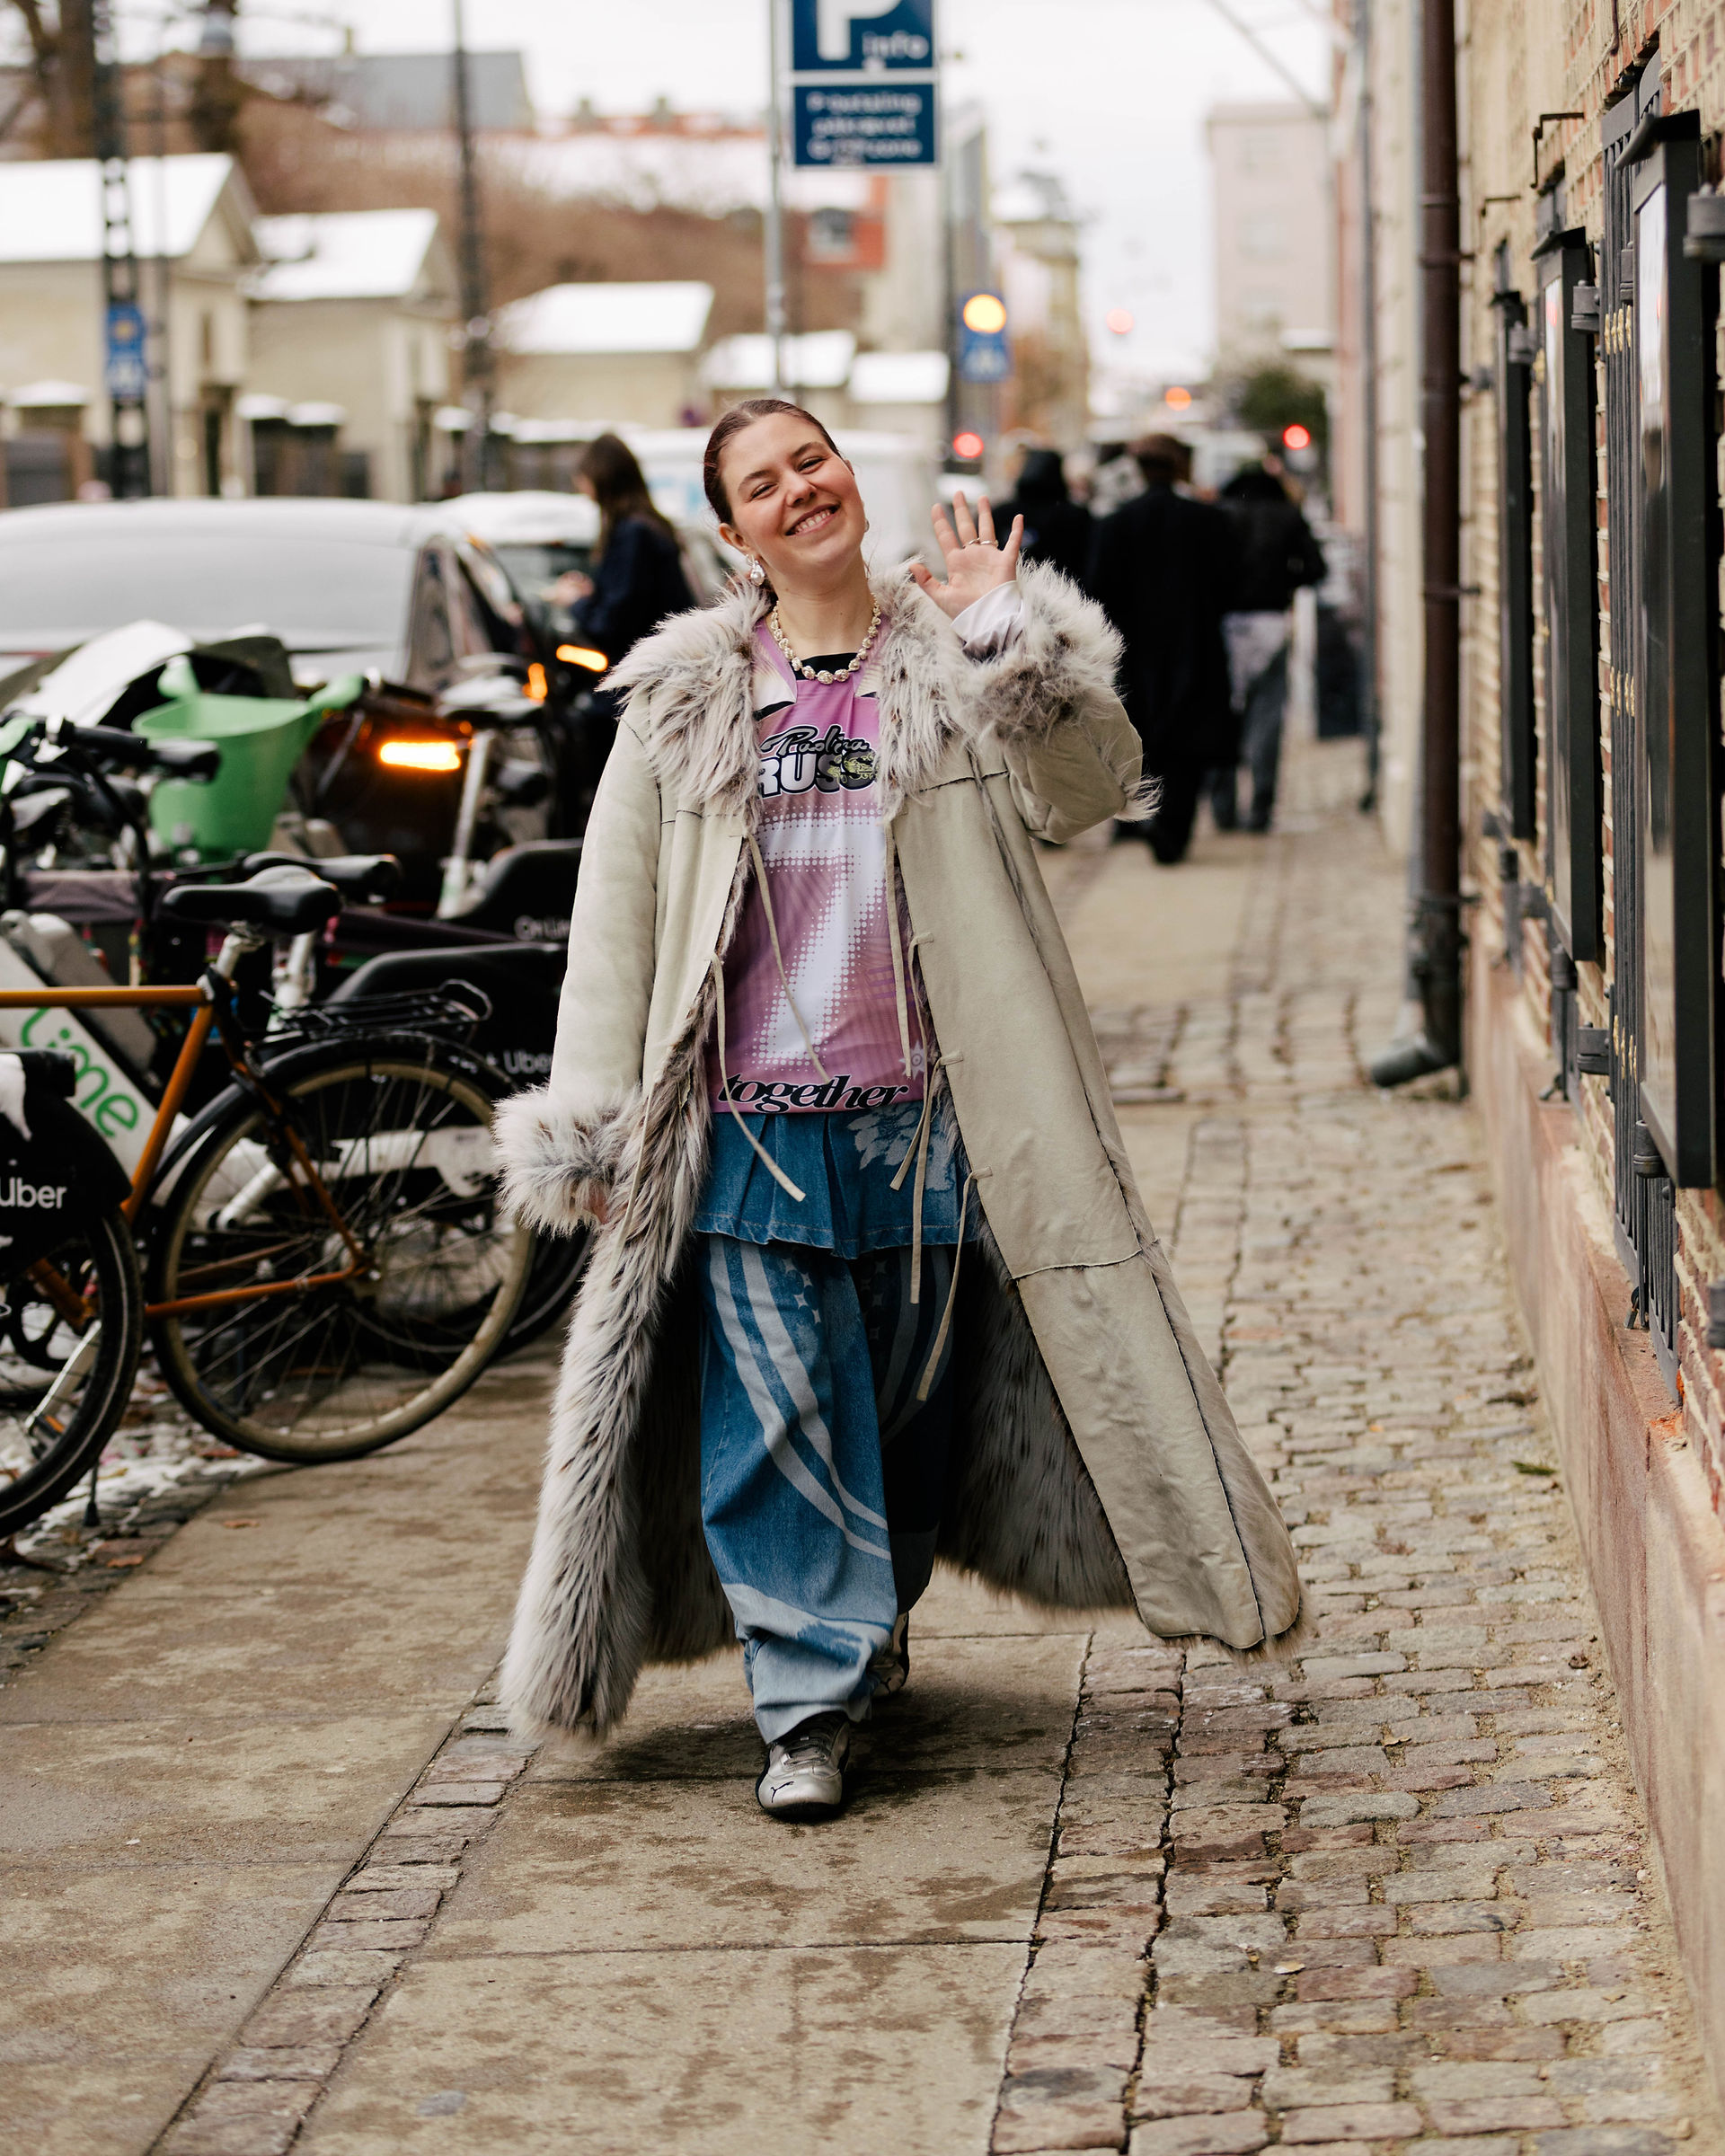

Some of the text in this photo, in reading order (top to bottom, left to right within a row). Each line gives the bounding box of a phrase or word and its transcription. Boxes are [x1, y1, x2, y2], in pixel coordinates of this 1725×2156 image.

[817, 0, 905, 61] P
[503, 1051, 552, 1074] Ube
[718, 1074, 909, 1113] together
[0, 1177, 67, 1209] Uber
